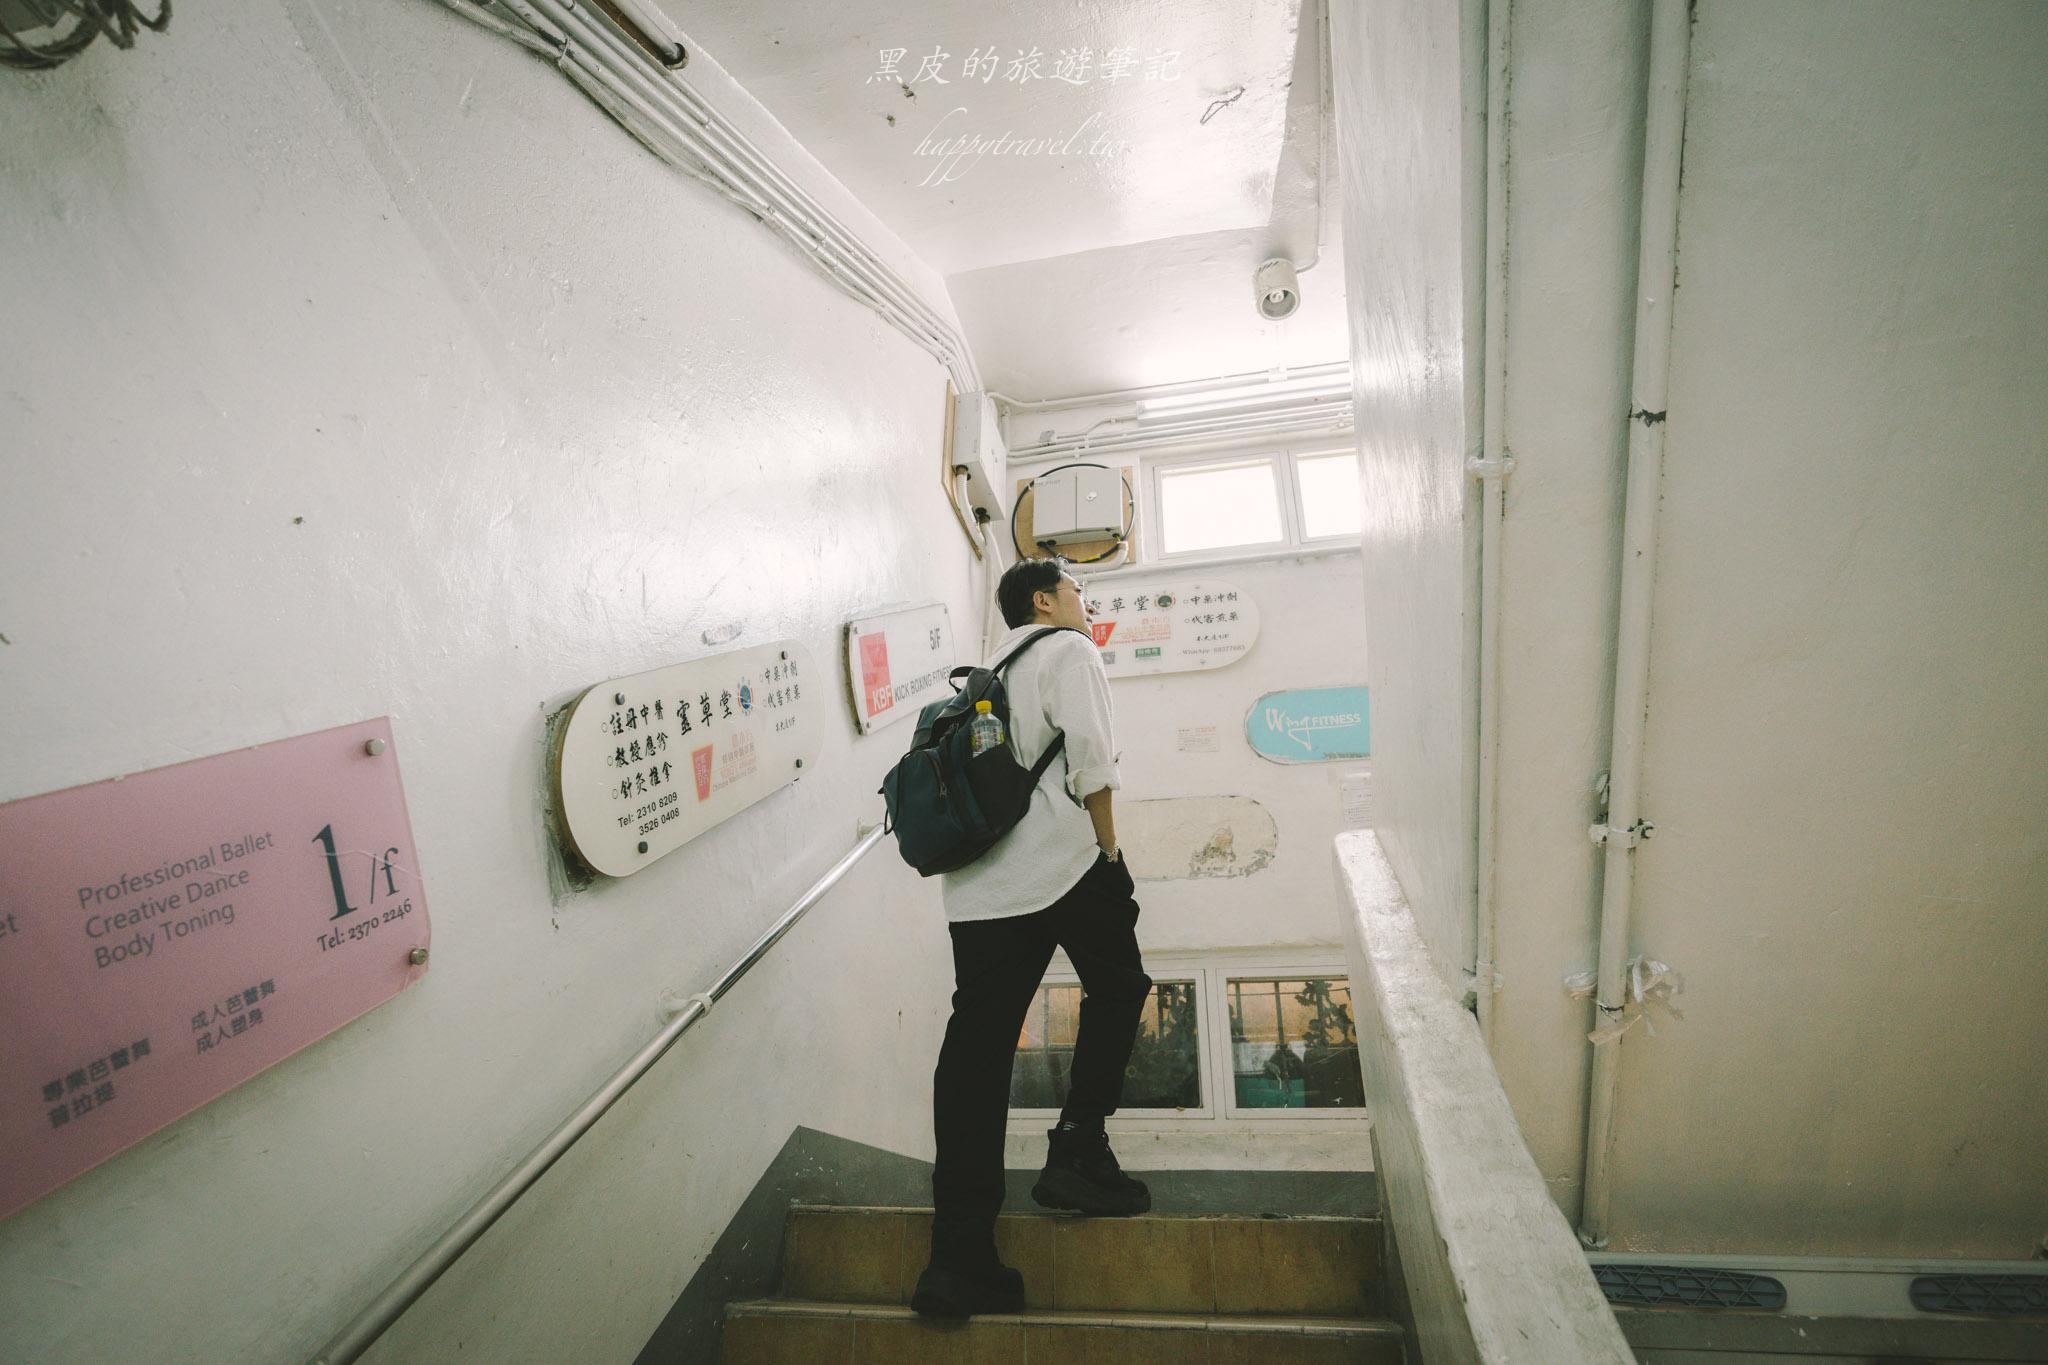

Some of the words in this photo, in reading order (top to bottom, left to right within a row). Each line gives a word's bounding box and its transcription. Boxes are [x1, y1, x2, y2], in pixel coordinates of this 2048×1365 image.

[894, 682, 910, 702] KICK
[910, 673, 932, 695] BOXING
[1312, 713, 1361, 728] FITNESS
[617, 813, 635, 828] Tel:
[637, 801, 657, 820] 2310
[658, 791, 678, 808] 8209
[639, 818, 660, 836] 3526
[660, 807, 680, 825] 0408
[77, 847, 217, 910] Professional
[220, 831, 275, 863] Ballet
[84, 893, 182, 939] Creative
[185, 869, 250, 904] Dance
[316, 926, 346, 952] Tel:
[347, 917, 380, 941] 2370
[382, 898, 412, 924] 2246
[93, 932, 156, 969] Body
[160, 903, 236, 942] Toning
